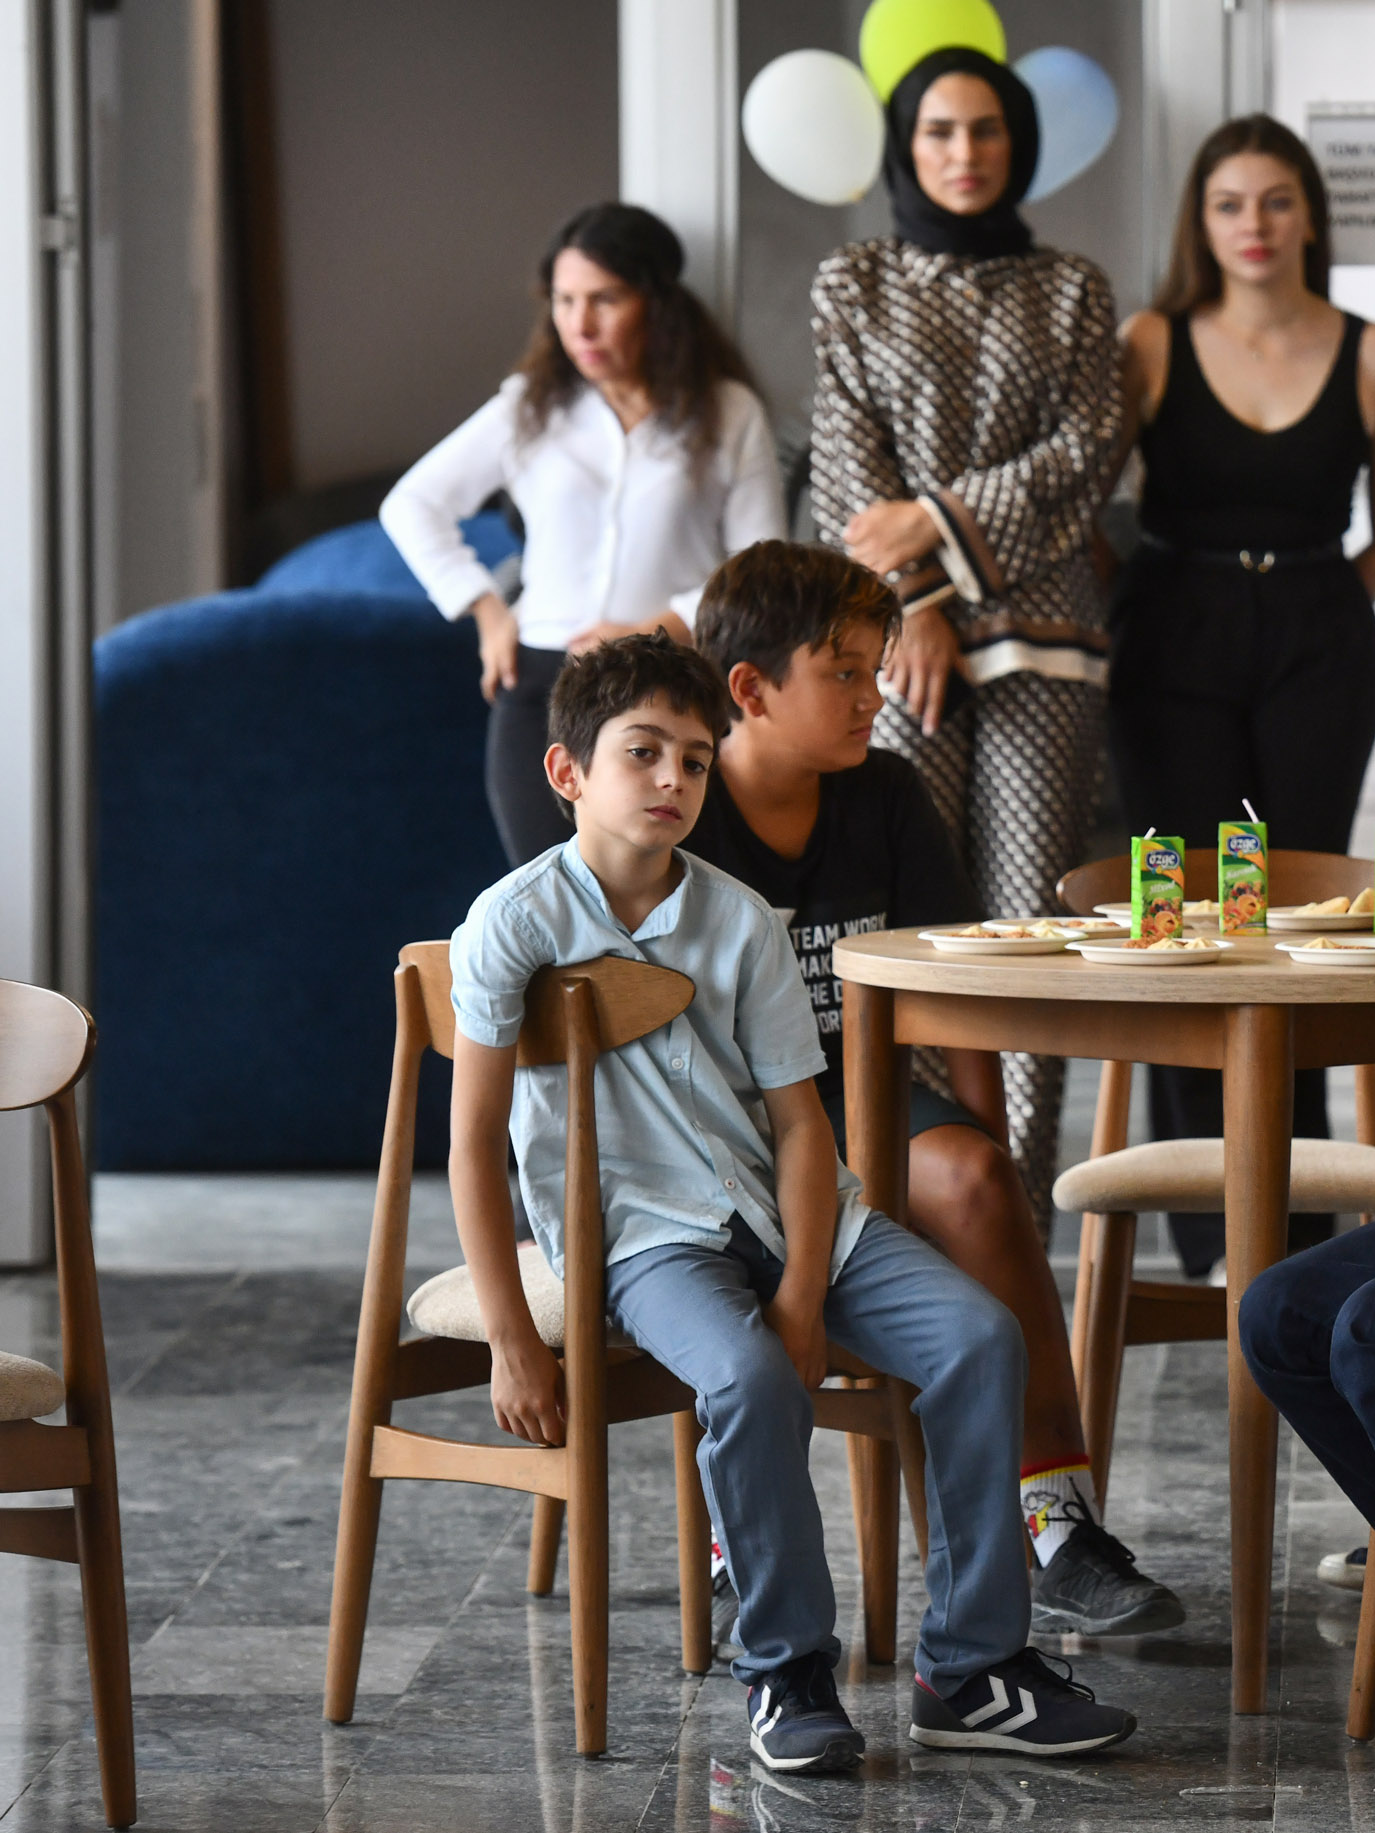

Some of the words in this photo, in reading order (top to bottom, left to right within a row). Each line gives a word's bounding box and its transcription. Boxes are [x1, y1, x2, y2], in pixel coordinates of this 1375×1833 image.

[790, 924, 839, 951] TEAM
[843, 911, 887, 937] WORK
[806, 981, 830, 1006] HE
